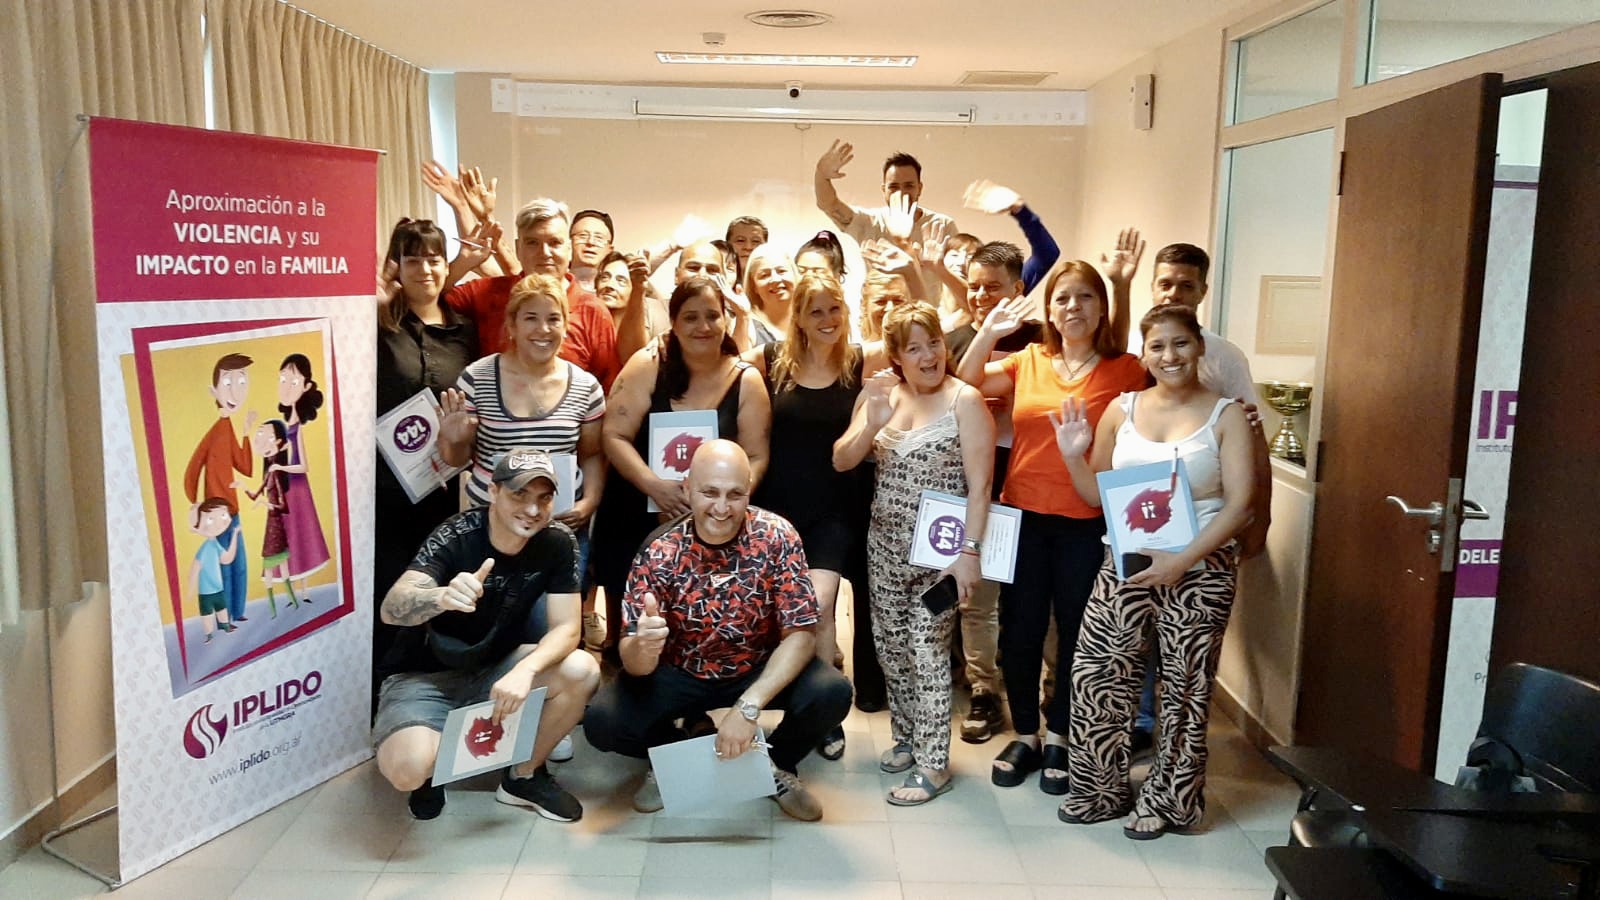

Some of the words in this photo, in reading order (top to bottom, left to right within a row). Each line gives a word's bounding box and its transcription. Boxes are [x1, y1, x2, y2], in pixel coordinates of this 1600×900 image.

[166, 189, 292, 215] Aproximación
[297, 201, 307, 216] a
[312, 197, 325, 217] la
[173, 222, 282, 245] VIOLENCIA
[287, 231, 297, 249] y
[301, 231, 320, 246] su
[136, 254, 230, 276] IMPACTO
[234, 258, 256, 275] en
[261, 255, 276, 275] la
[281, 256, 349, 275] FAMILIA
[396, 420, 427, 446] 144
[935, 520, 956, 550] 144
[1459, 548, 1501, 565] DELE
[233, 670, 322, 727] IPLIDO
[209, 732, 302, 785] www.iplido.org.ar
